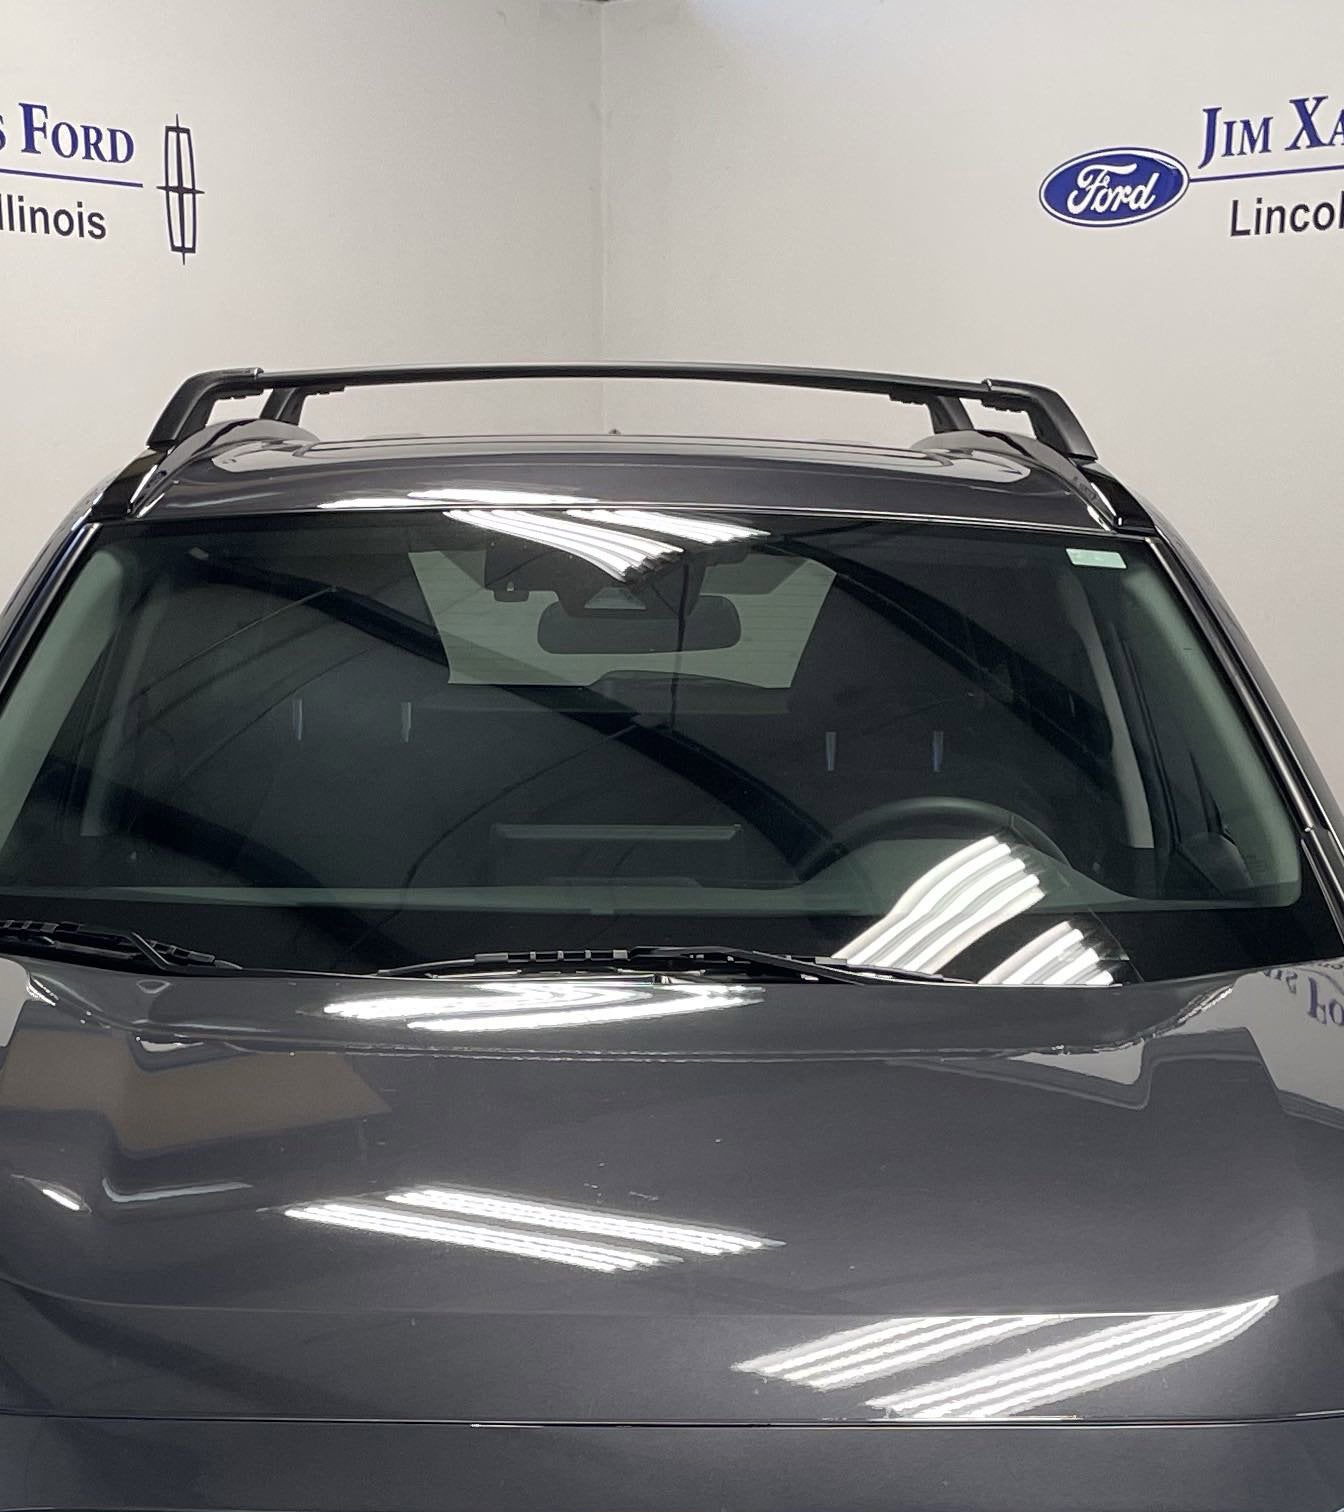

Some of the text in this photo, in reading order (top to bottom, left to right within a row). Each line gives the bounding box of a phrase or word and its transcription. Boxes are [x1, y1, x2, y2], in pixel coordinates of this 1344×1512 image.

[20, 103, 134, 164] FORD
[1198, 107, 1273, 168] JIM
[1067, 161, 1159, 214] Ford
